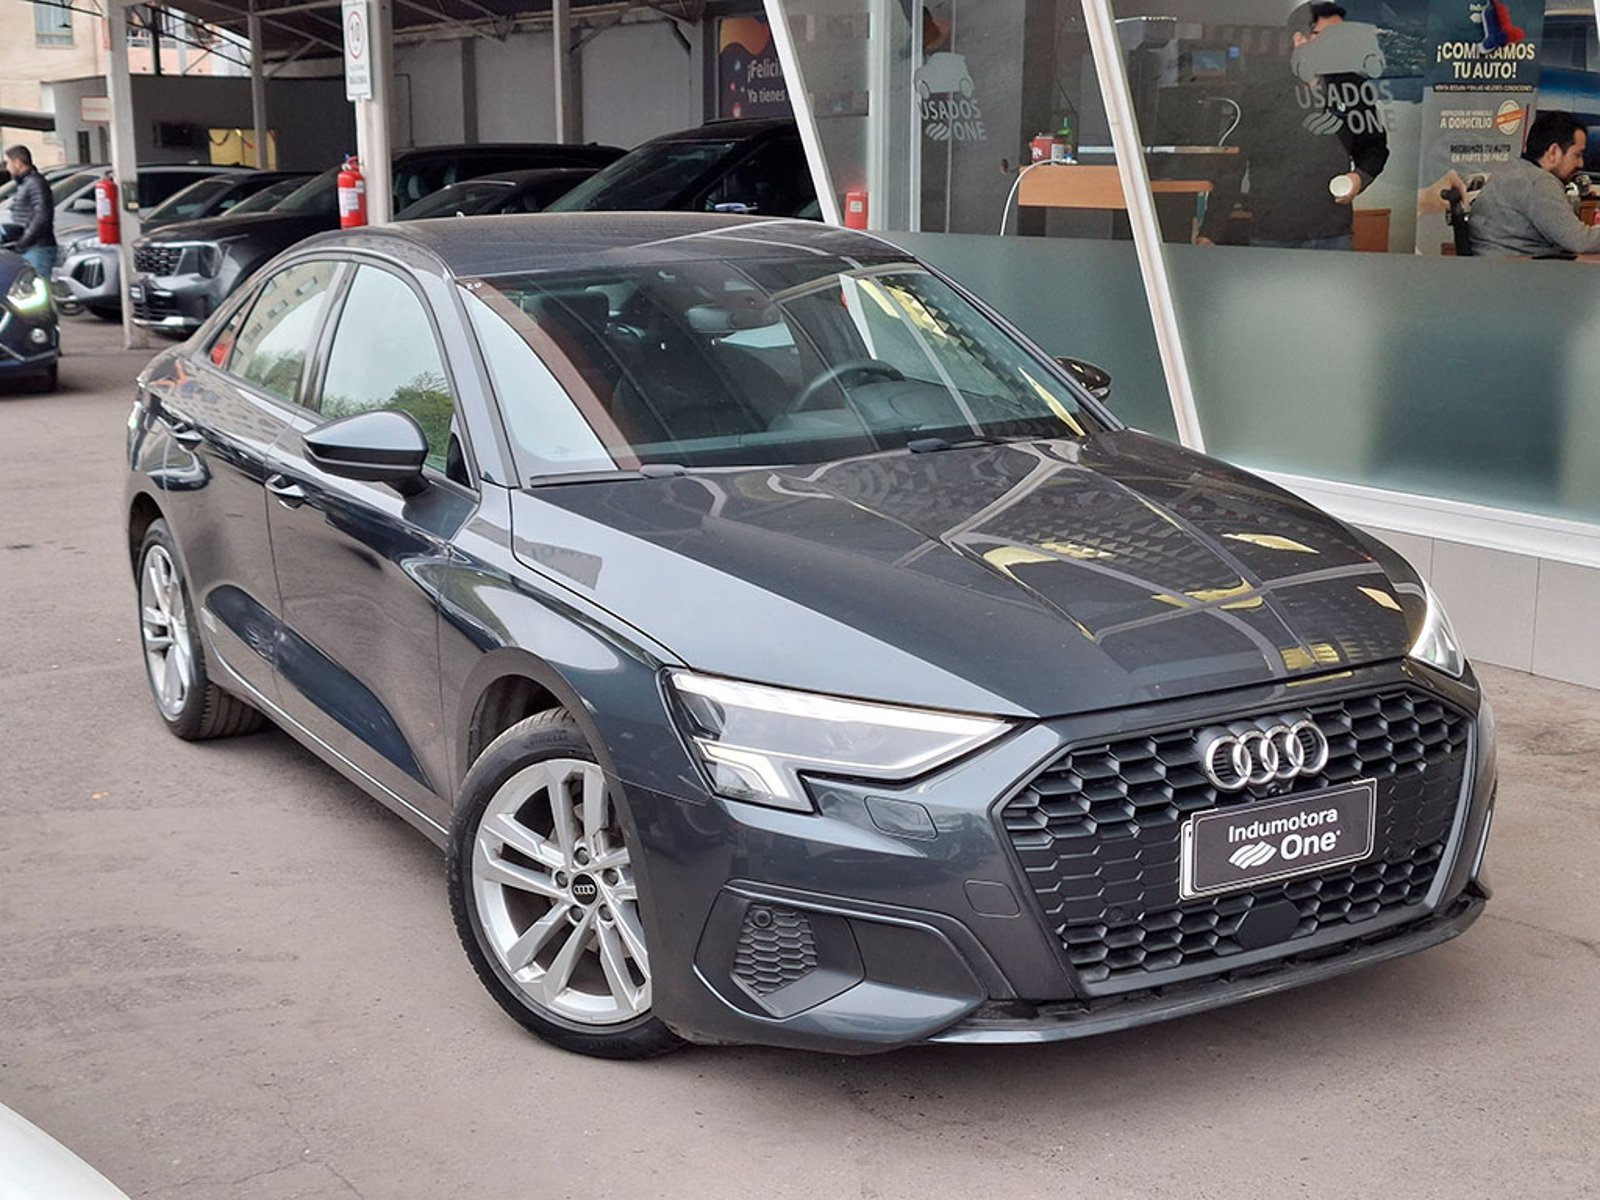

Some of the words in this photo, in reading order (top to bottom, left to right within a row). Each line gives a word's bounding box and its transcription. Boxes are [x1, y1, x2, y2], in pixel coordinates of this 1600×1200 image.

[1452, 61, 1471, 79] TU
[1472, 61, 1517, 79] AUTO!
[759, 88, 786, 102] tienes
[1295, 79, 1394, 109] USADOS
[917, 99, 981, 120] USADOS
[953, 121, 987, 141] ONE
[1347, 109, 1396, 136] ONE
[1440, 116, 1448, 129] A
[1448, 116, 1493, 129] DOMICILIO
[1228, 808, 1338, 843] Indumotora
[1280, 831, 1337, 860] One
